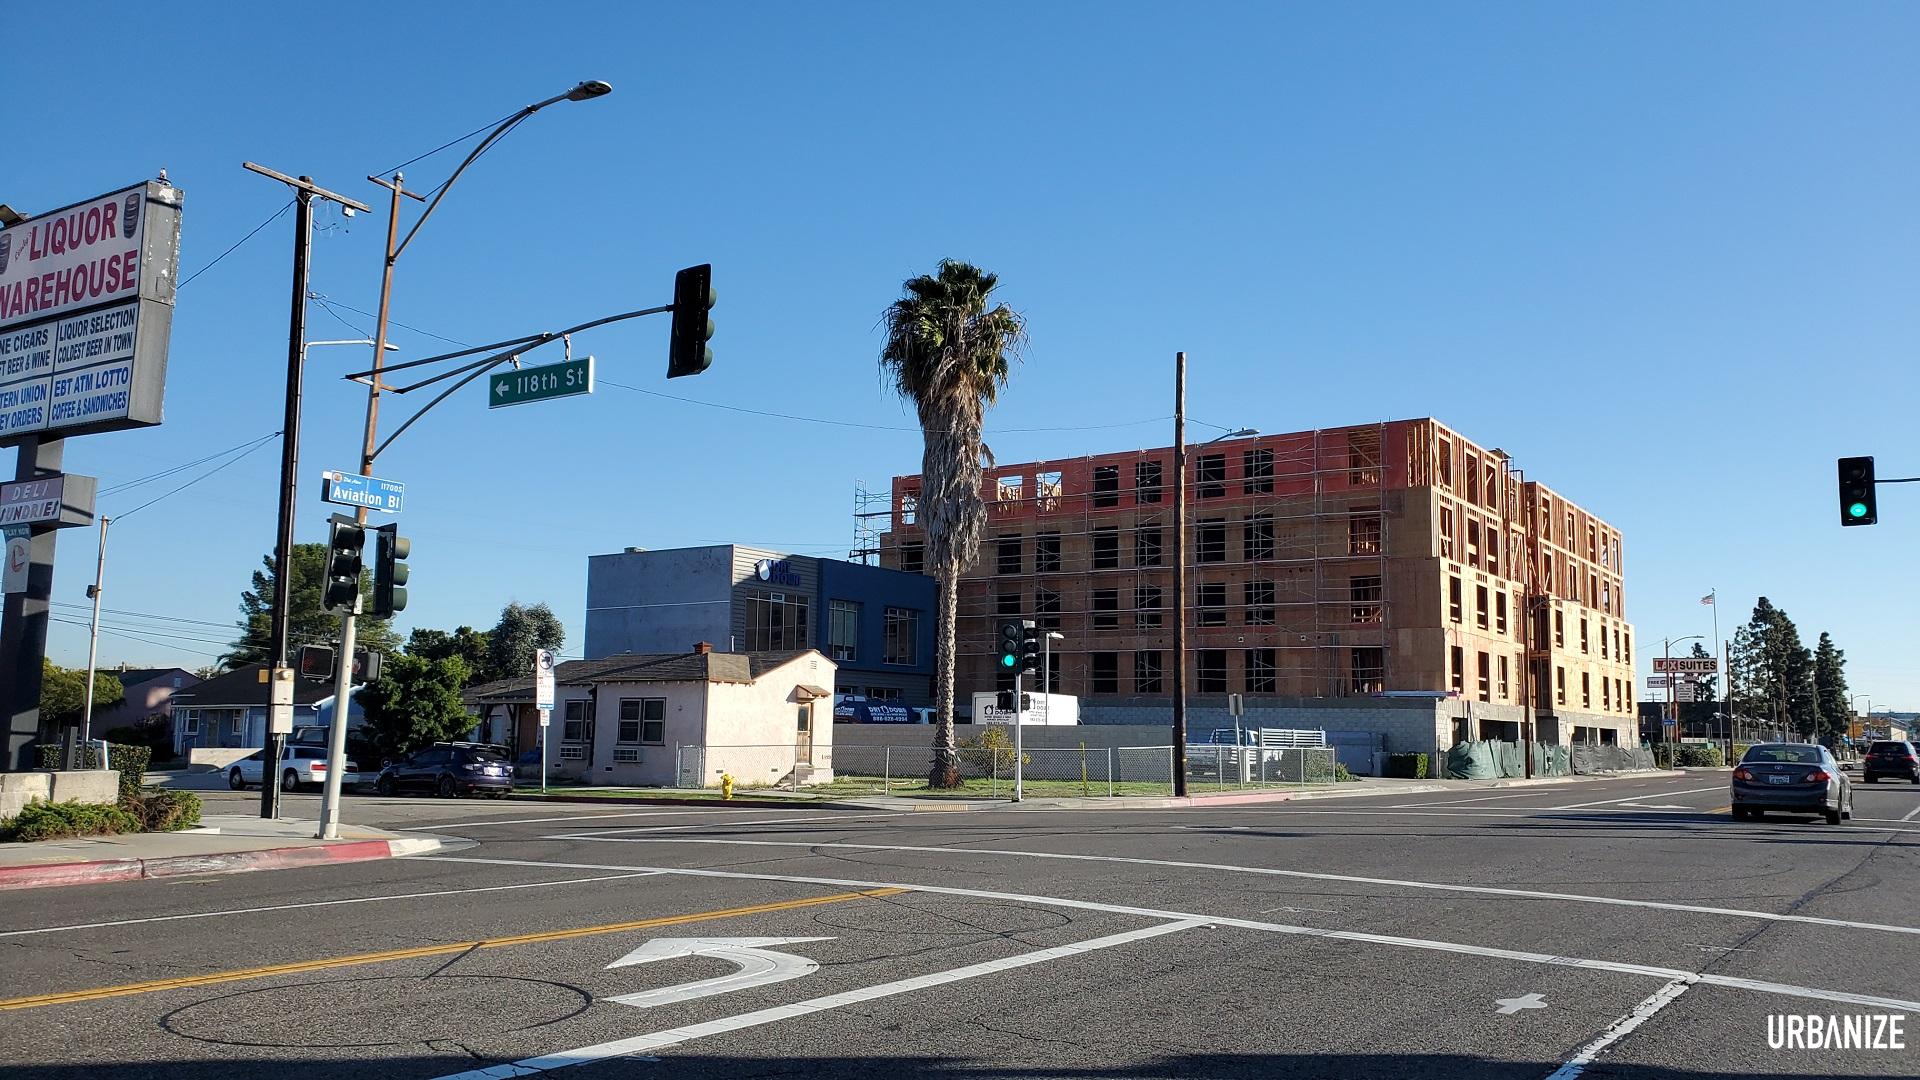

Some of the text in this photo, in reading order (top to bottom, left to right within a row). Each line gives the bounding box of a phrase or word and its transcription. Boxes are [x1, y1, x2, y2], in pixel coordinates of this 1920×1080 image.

[29, 202, 118, 261] LIQUOR
[59, 308, 136, 341] LIQUOR SELECTION
[13, 329, 48, 352] CIGARS
[58, 332, 133, 363] COLDEST BEER IN TOWN
[7, 356, 24, 375] BEER
[25, 354, 30, 370] &
[31, 350, 50, 369] WINE
[54, 367, 129, 397] EBT ATM LOTTO
[517, 367, 584, 394] 118th St
[20, 384, 47, 405] UNION
[52, 391, 127, 420] COFFEE & SANDWICHES
[11, 407, 42, 428] ORDERS
[12, 482, 49, 500] DELI
[333, 486, 400, 509] Aviation Bl
[0, 500, 59, 522] SUNDRIES
[1655, 660, 1716, 671] LAX SUITES
